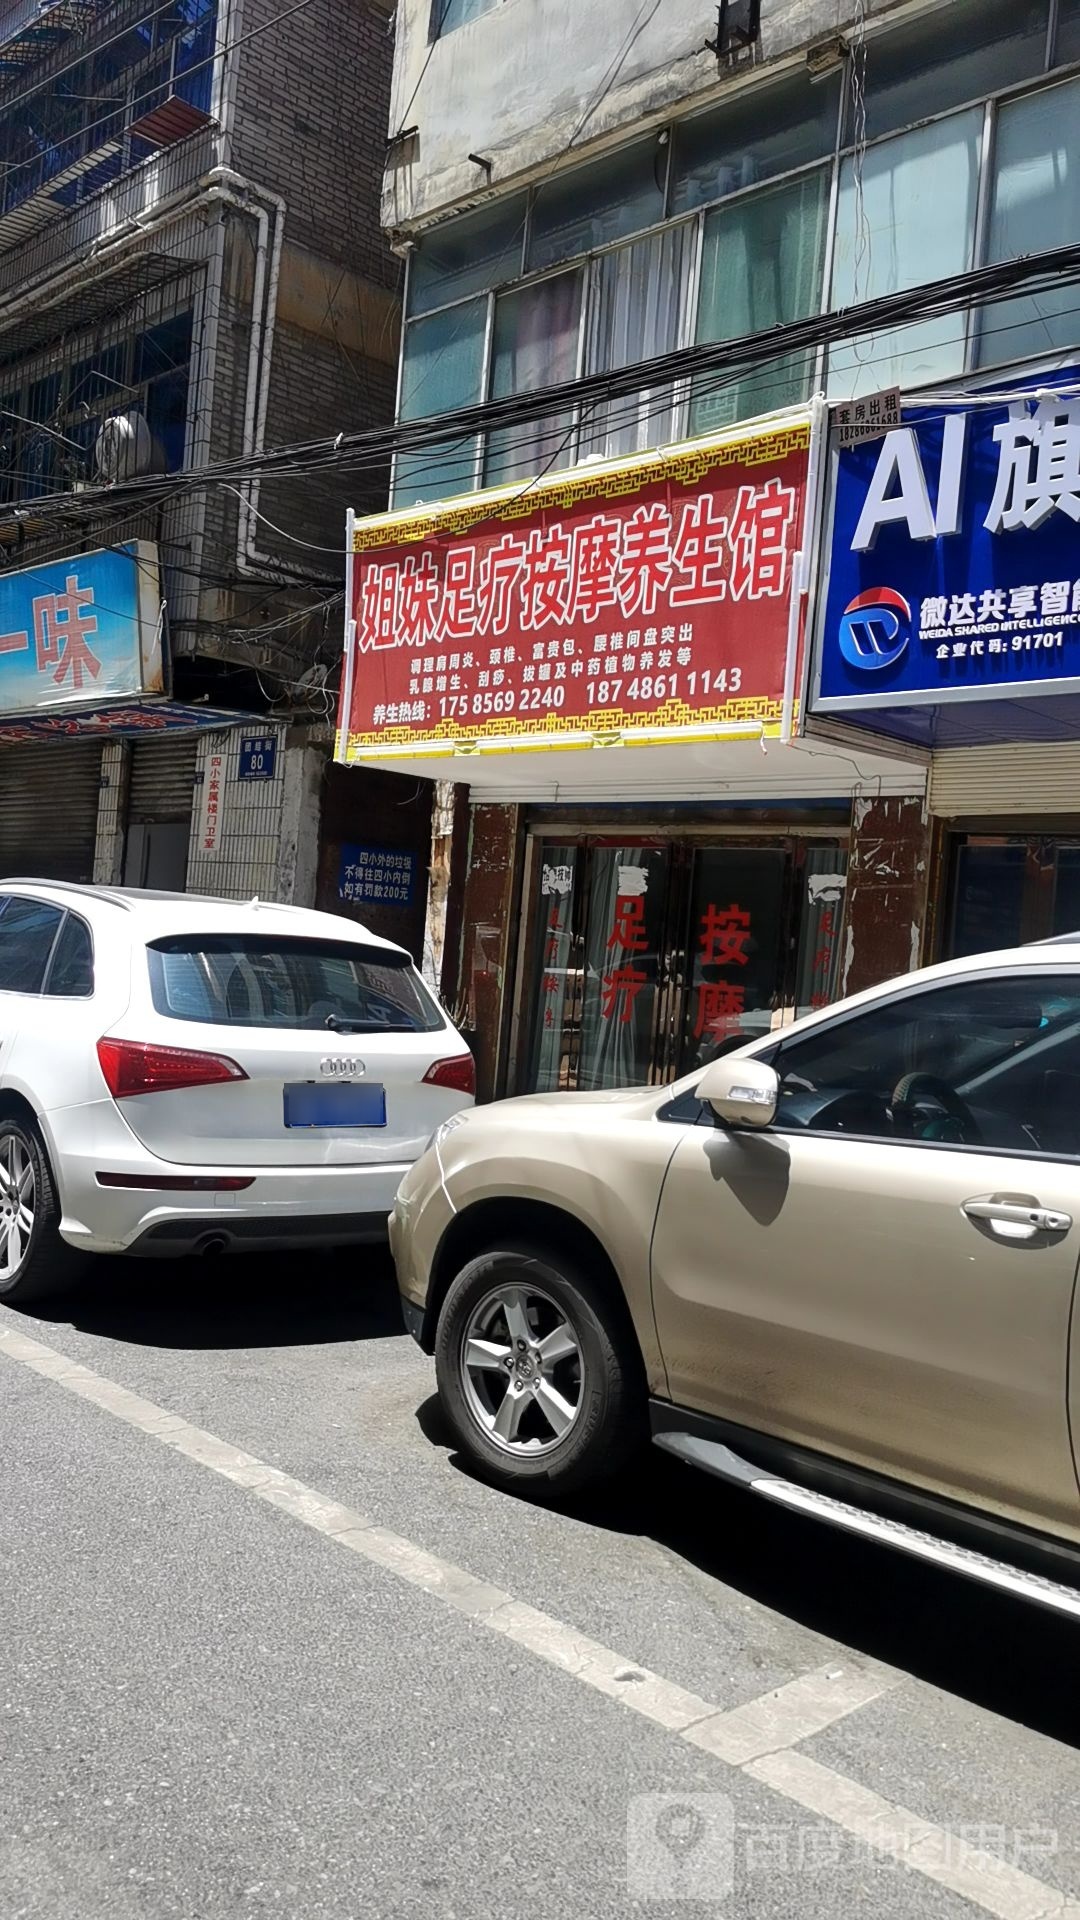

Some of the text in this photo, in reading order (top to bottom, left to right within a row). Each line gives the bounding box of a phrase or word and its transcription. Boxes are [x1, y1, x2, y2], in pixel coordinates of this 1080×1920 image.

[839, 394, 897, 424] 套房出租
[359, 478, 797, 653] 姐妹足疗按摩养生馆
[919, 578, 1080, 630] 微达共享智
[410, 623, 694, 675] 调理肩周炎、颈椎、富贵包、腰椎间盘突出
[919, 627, 954, 640] WEIDA
[954, 622, 1000, 636] SHARED
[1011, 631, 1064, 651] 91701
[408, 647, 692, 695] 乳腺增生、刮痧、拔罐及中药植物养发等
[439, 694, 468, 717] 175
[472, 690, 515, 715] 8569
[519, 685, 565, 711] 2240
[586, 679, 623, 704] 187
[627, 673, 678, 700] 4861
[687, 667, 742, 696] 1143
[250, 754, 264, 770] 80
[203, 756, 222, 849] 四小家属楼门卫室
[344, 864, 411, 885] 不得往四小内倒
[359, 851, 412, 870] 四小外的垃圾
[343, 881, 409, 901] 如有罚款200元
[601, 895, 649, 1023] 足疗
[693, 903, 751, 1042] 按摩
